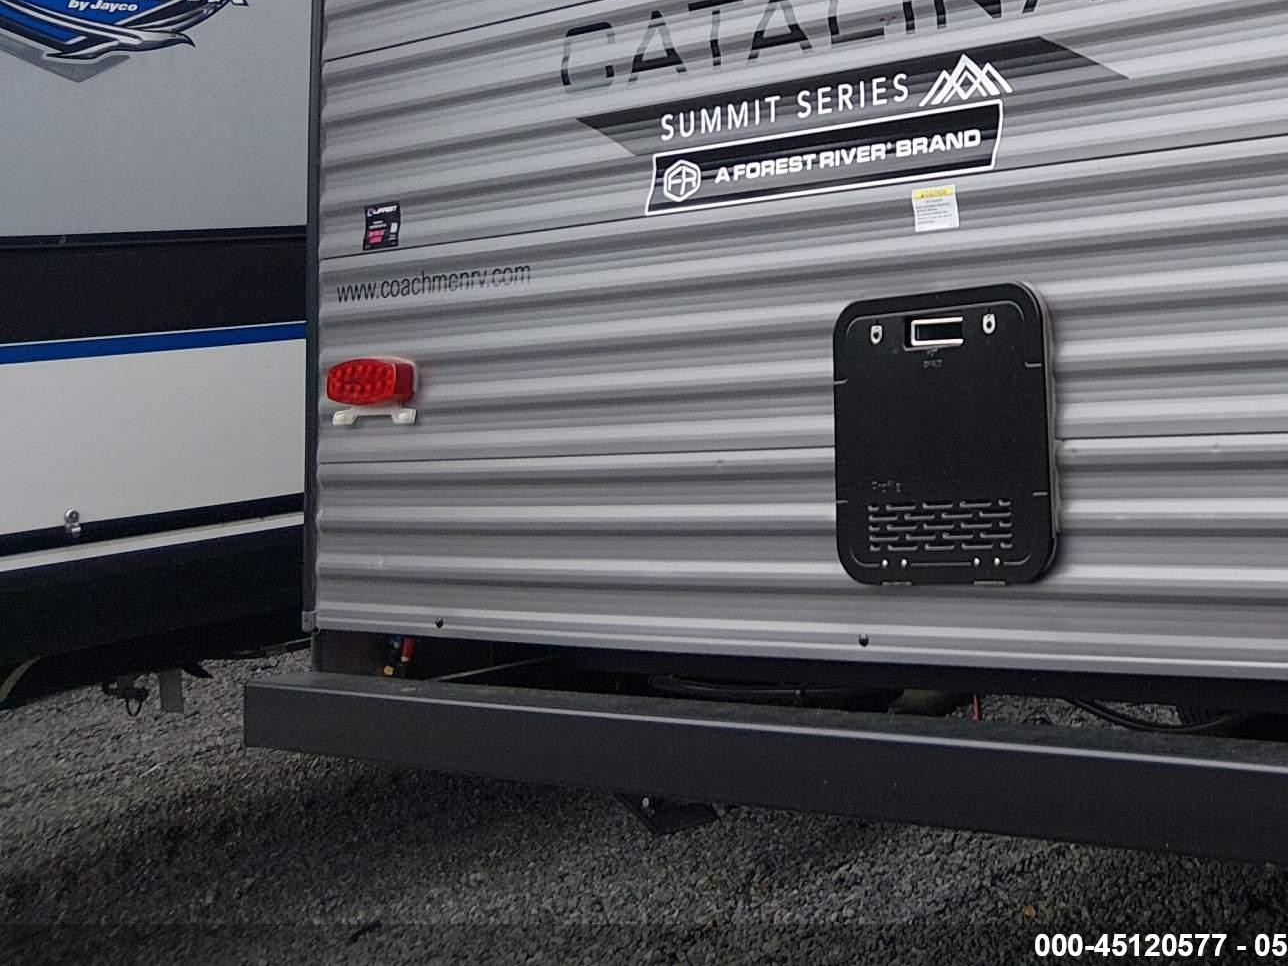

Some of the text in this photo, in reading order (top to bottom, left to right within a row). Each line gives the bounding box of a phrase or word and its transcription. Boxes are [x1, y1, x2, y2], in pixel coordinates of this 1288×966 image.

[91, 0, 138, 12] Jayco
[660, 72, 910, 141] SUMMIT SERIES
[714, 166, 731, 184] A
[733, 153, 817, 181] FOREST
[895, 129, 982, 158] BRAND
[336, 264, 532, 303] www.coachmenrv.com
